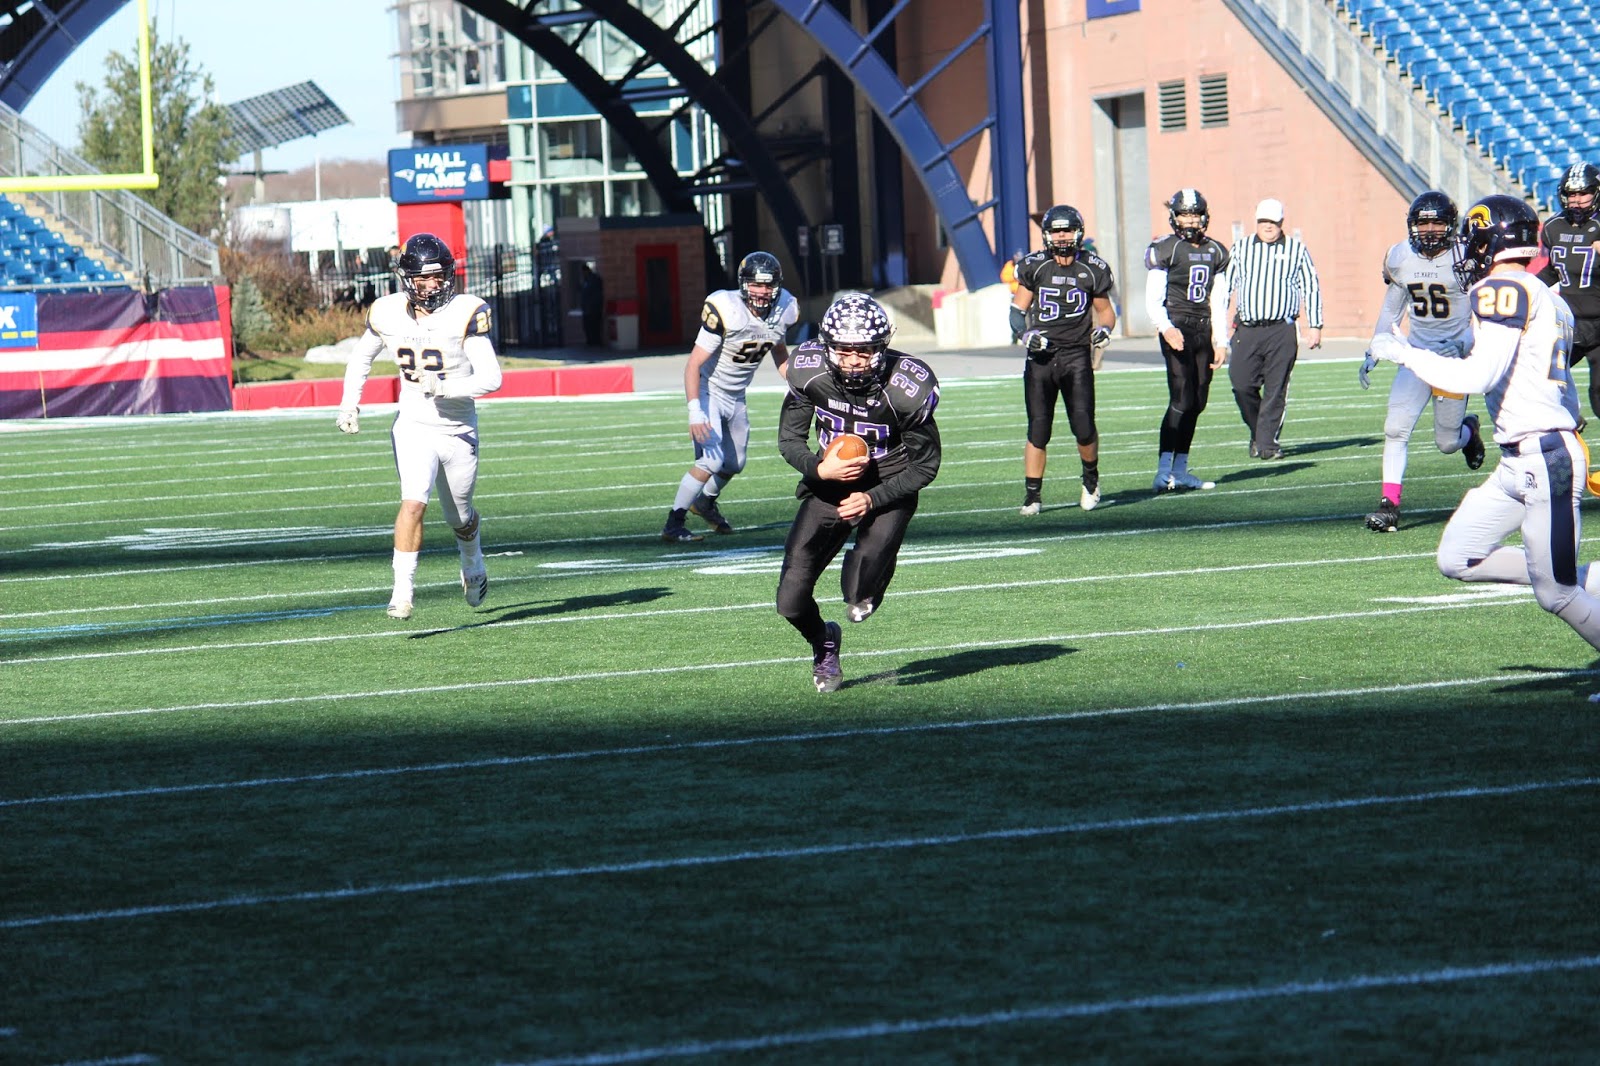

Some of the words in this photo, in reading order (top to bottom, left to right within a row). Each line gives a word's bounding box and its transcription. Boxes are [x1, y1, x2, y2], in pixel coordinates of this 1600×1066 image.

[414, 152, 467, 169] HALL
[416, 171, 467, 189] FAME
[1187, 264, 1210, 303] 8
[1551, 246, 1596, 288] 67
[1039, 286, 1087, 321] 52
[1406, 282, 1450, 319] 56
[1477, 285, 1519, 317] 20
[890, 358, 930, 398] 33
